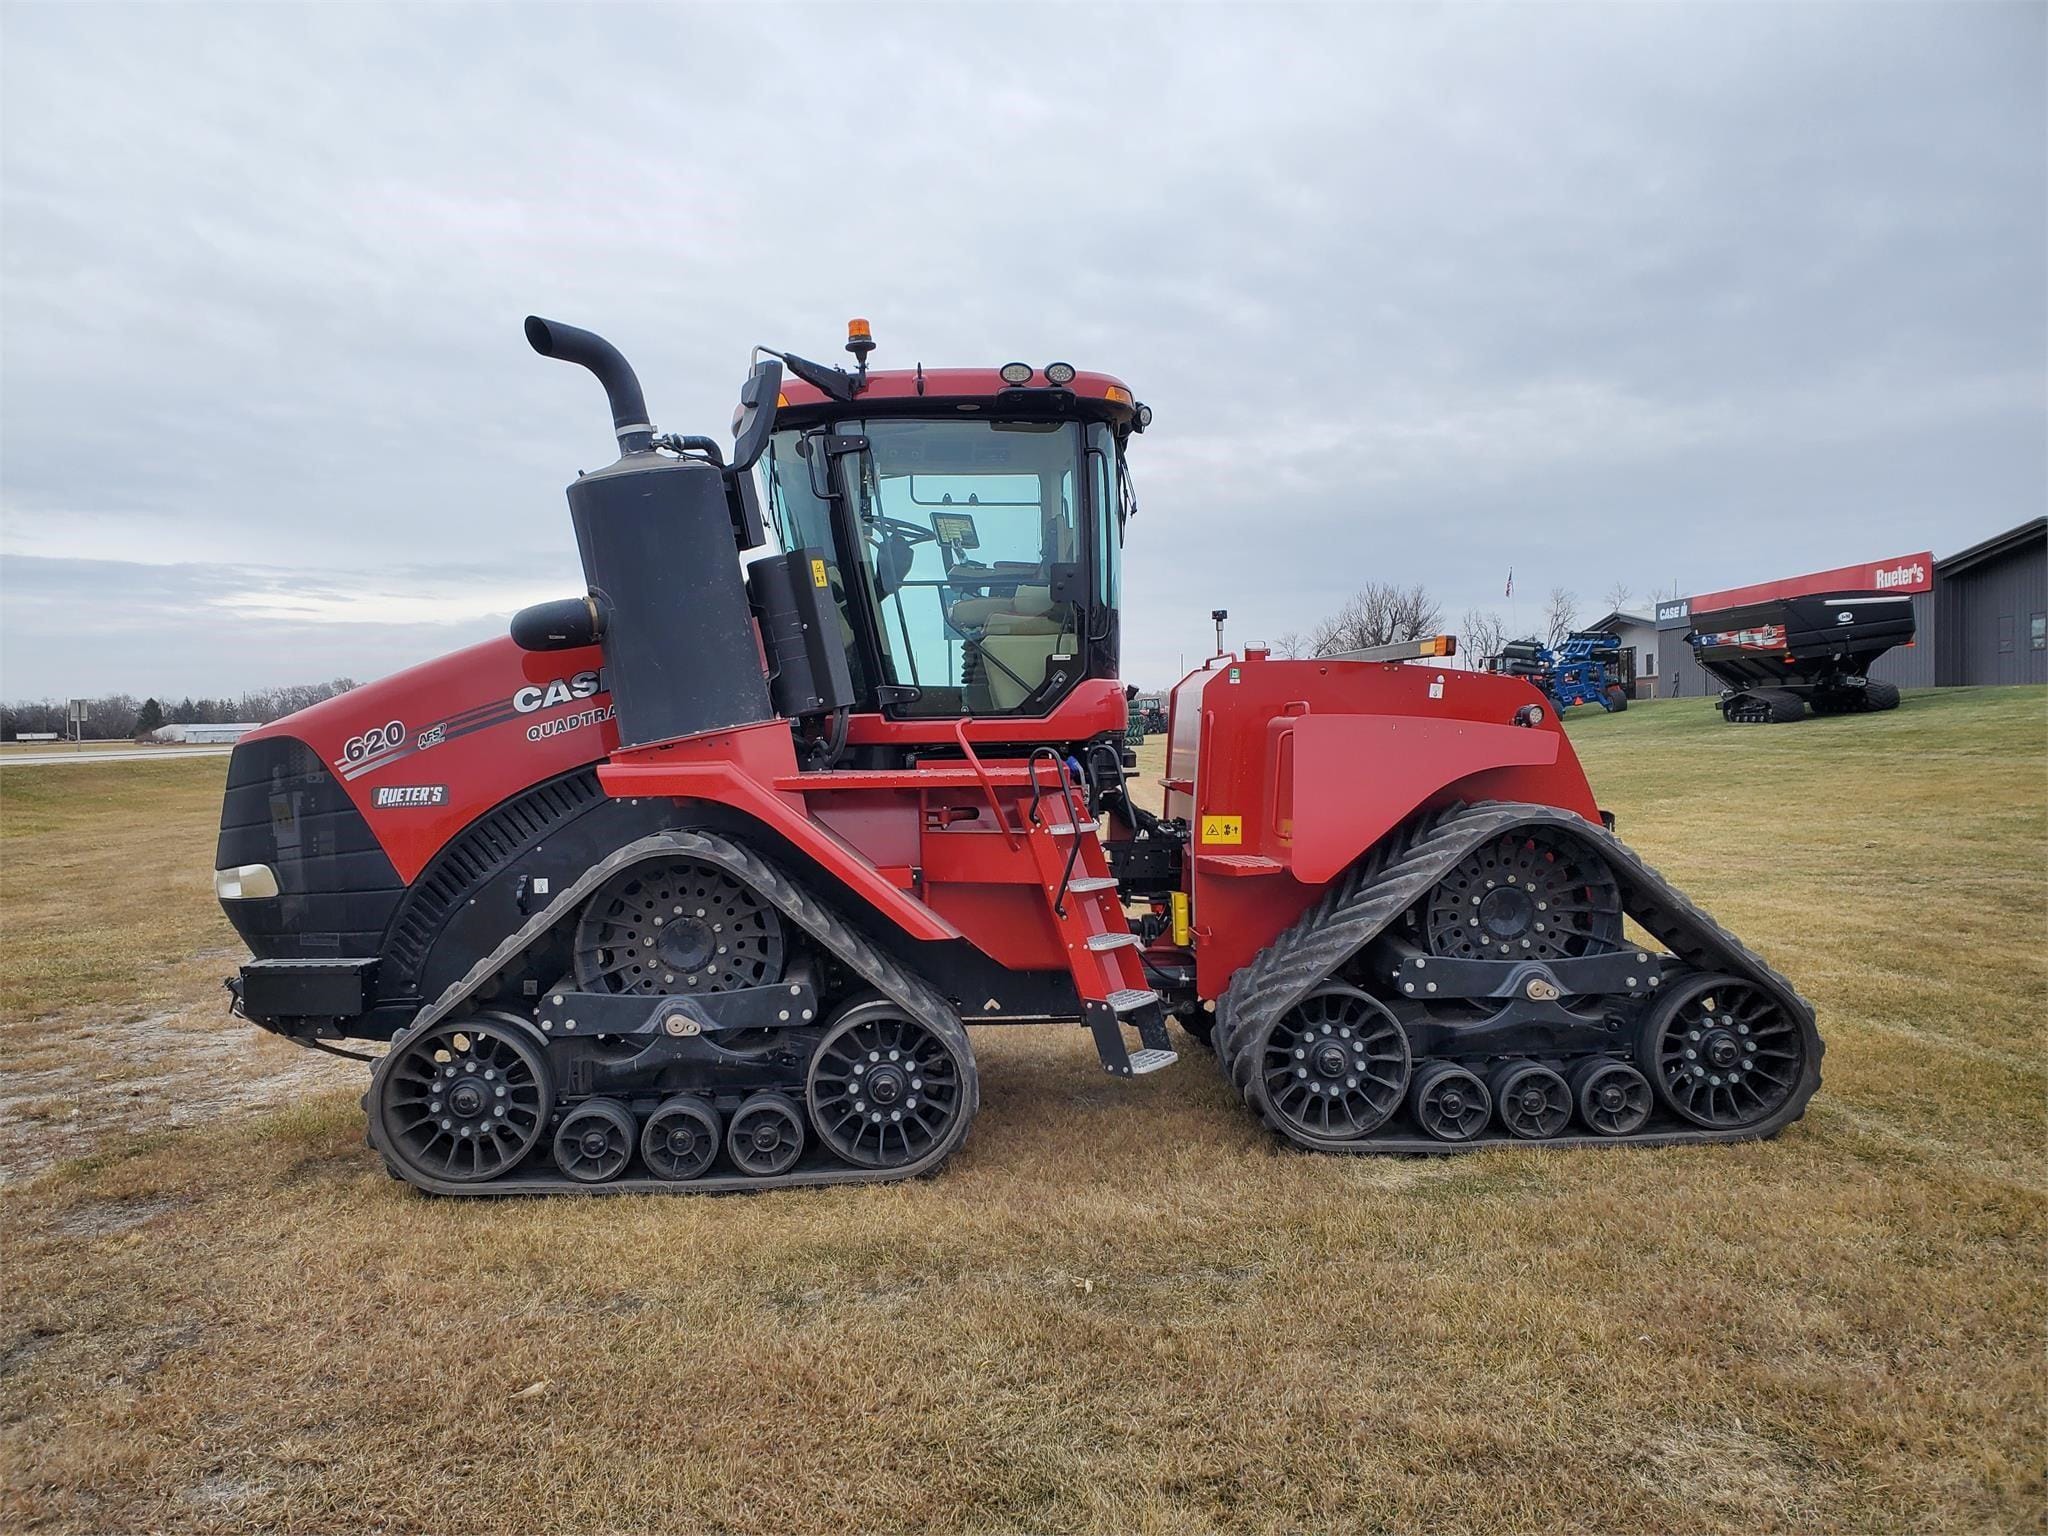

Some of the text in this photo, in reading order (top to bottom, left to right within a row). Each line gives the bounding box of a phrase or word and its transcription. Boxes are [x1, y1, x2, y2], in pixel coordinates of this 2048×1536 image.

[1876, 563, 1924, 589] Rueter's
[1659, 606, 1680, 620] CASE
[344, 720, 406, 763] 620
[419, 728, 441, 746] AFS
[377, 786, 443, 805] RUETER'S
